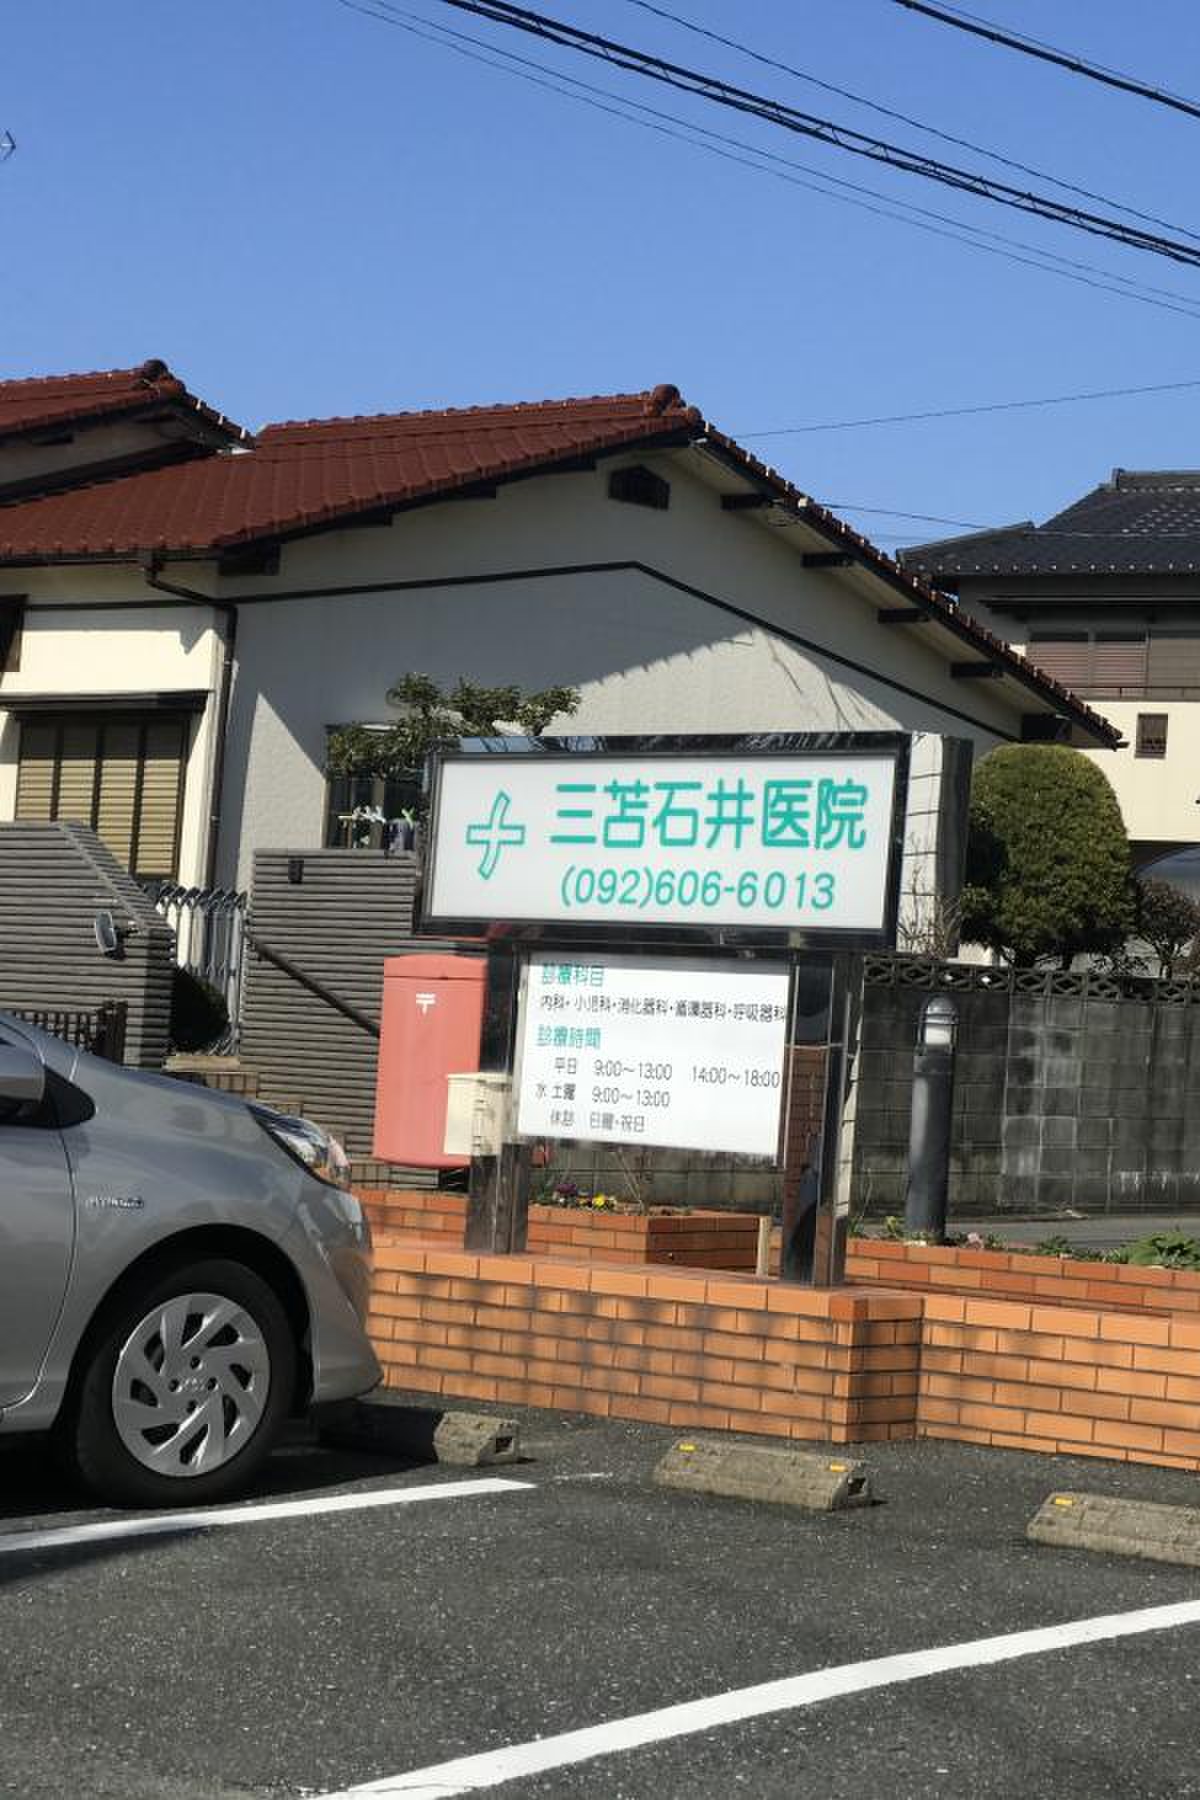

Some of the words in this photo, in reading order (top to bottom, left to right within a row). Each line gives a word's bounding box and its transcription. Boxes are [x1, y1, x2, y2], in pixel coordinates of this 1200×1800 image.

[550, 778, 868, 850] 三苔石井医院
[561, 865, 836, 910] (092)606-6013
[536, 1024, 602, 1049] 診療時間
[554, 1057, 577, 1075] 平日
